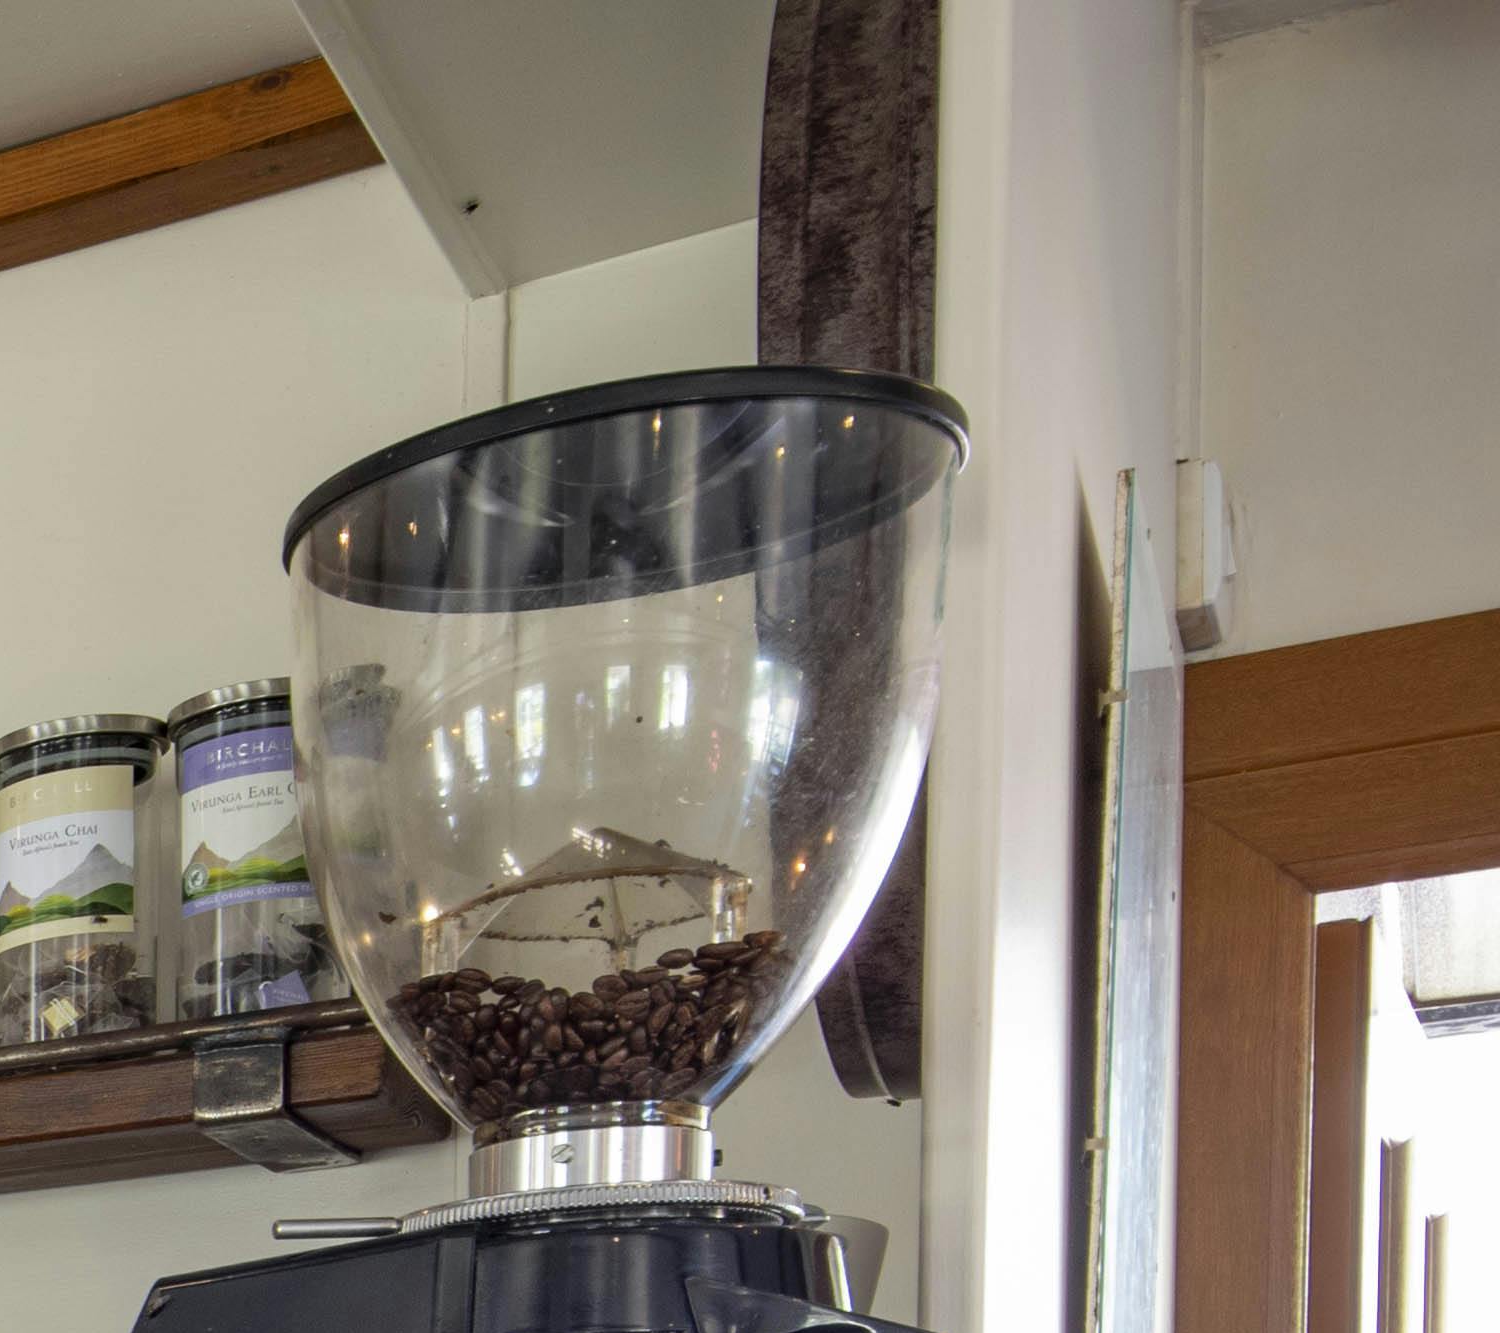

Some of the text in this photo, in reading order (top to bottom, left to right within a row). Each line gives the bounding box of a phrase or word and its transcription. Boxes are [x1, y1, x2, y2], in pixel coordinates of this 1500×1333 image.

[191, 790, 242, 813] VIRUNGA
[249, 783, 282, 799] EARL
[9, 831, 59, 851] VIRUNGA
[65, 824, 99, 837] CHAI
[257, 886, 297, 896] SCENTED
